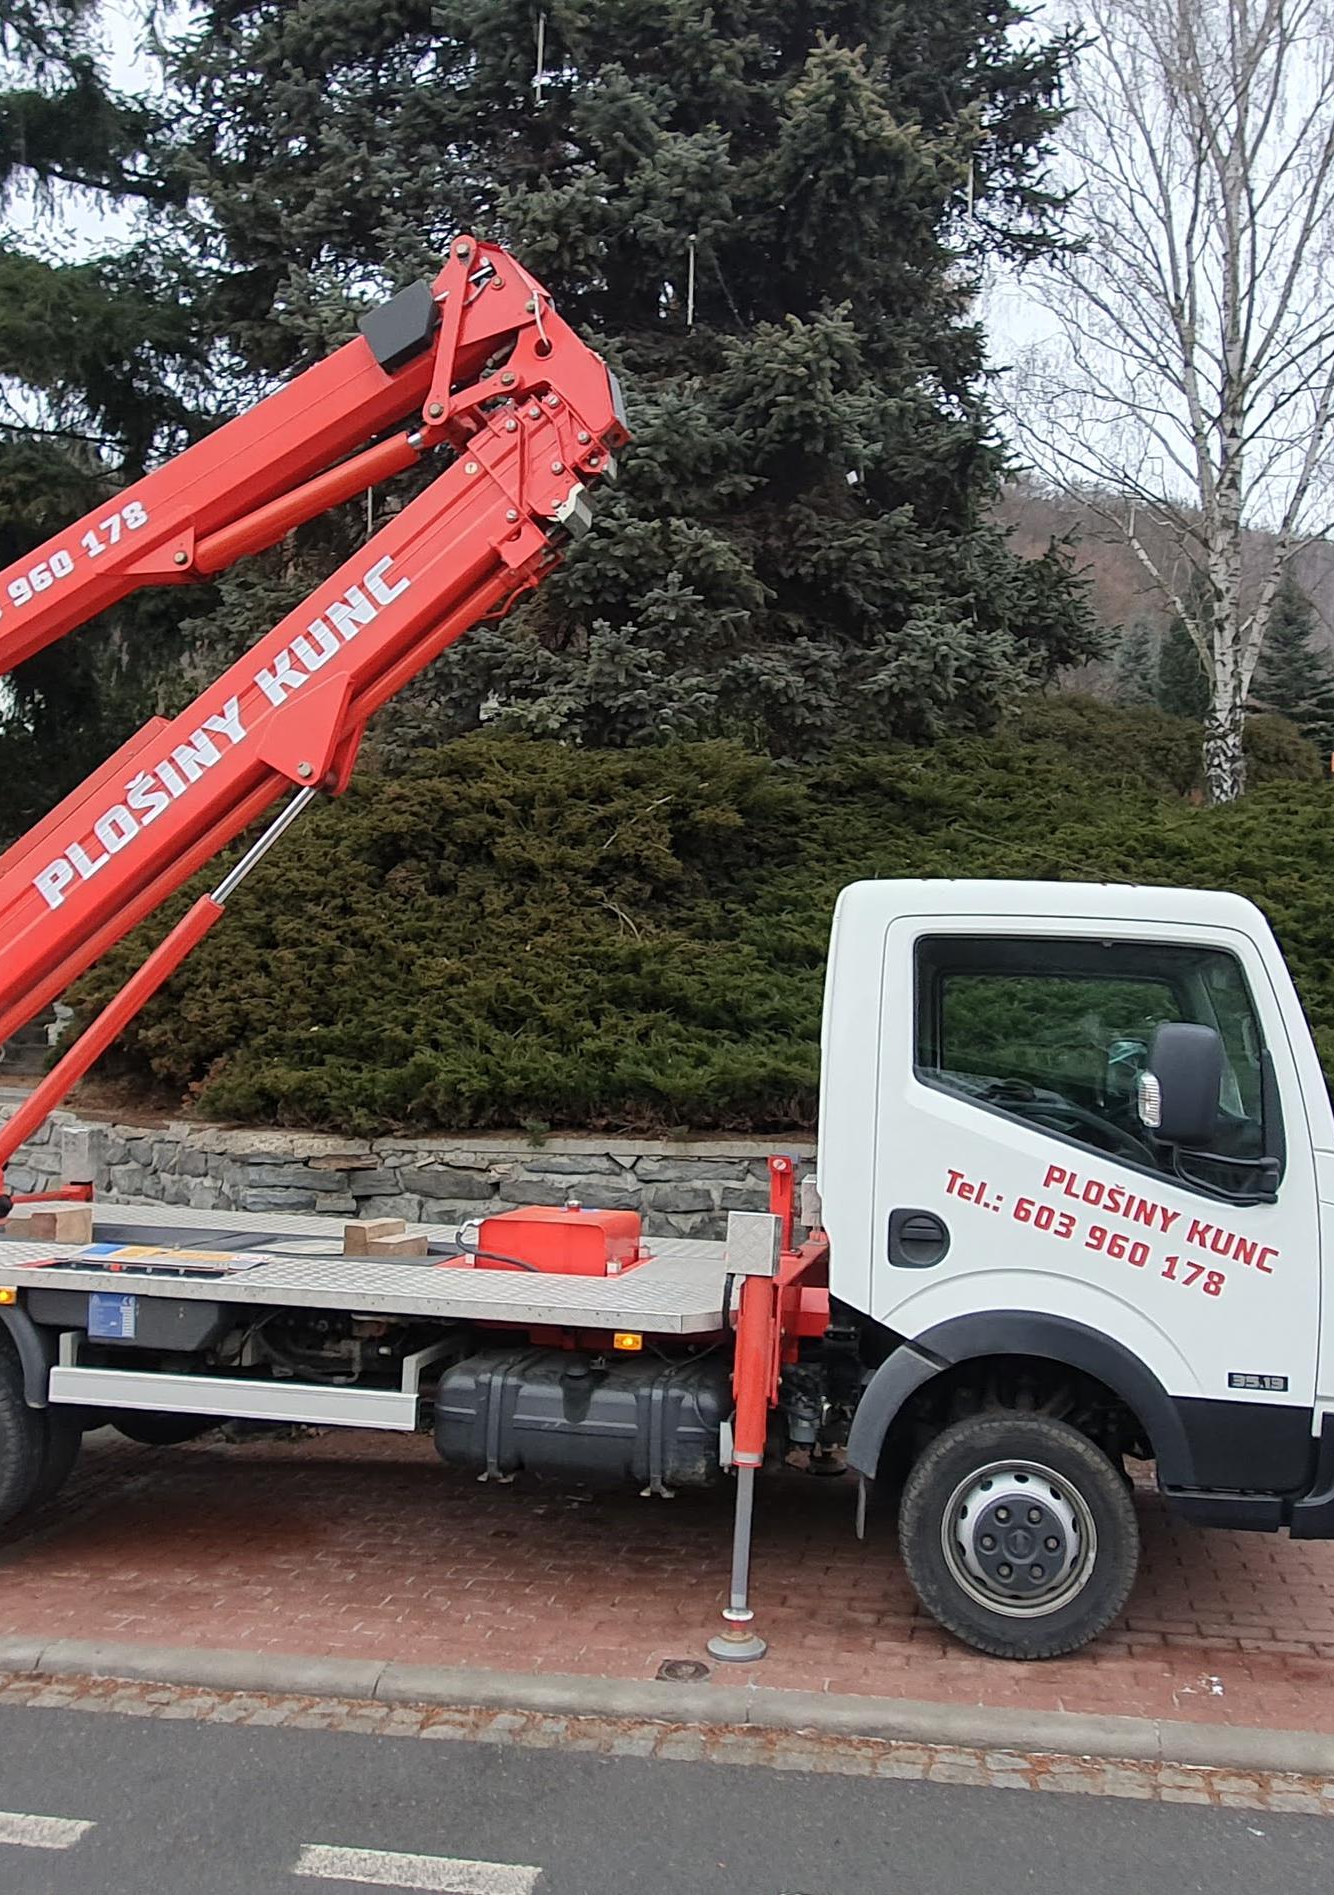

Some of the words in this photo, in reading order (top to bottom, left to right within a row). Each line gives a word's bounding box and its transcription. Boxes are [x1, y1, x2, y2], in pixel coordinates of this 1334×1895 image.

[7, 550, 75, 606] 960
[80, 501, 148, 558] 178
[33, 695, 247, 910] PLOŠINY
[253, 555, 411, 707] KUNC
[944, 1169, 1004, 1212] Tel.:
[1013, 1198, 1077, 1240] 603
[1085, 1225, 1150, 1268] 960
[1161, 1256, 1226, 1297] 178
[1043, 1165, 1181, 1233] PLOŠINY
[1187, 1219, 1279, 1274] KUNC
